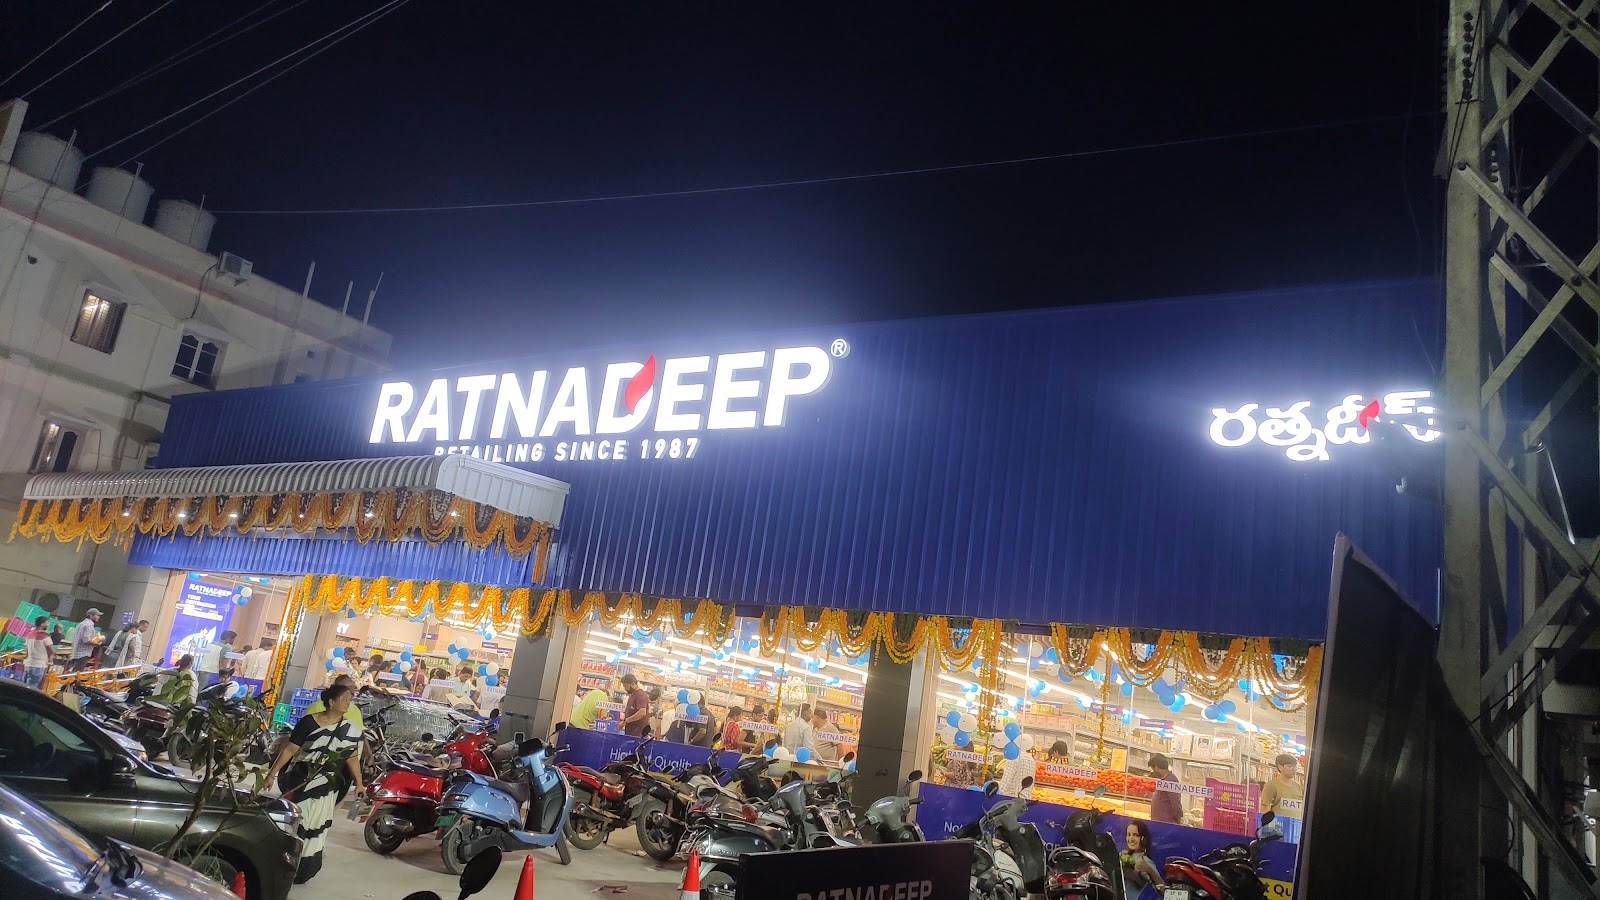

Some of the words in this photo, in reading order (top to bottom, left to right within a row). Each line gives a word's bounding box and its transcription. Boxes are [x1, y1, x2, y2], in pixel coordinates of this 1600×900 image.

[554, 440, 627, 462] SINCE
[640, 437, 699, 460] 1987
[595, 701, 626, 711] RATNADEEP
[742, 721, 779, 732] RATNADEEP
[817, 732, 857, 743] RATNADEEP
[654, 755, 692, 772] Qualit
[1046, 764, 1097, 778] RATNADEEP
[1156, 780, 1214, 796] RATNADEEP
